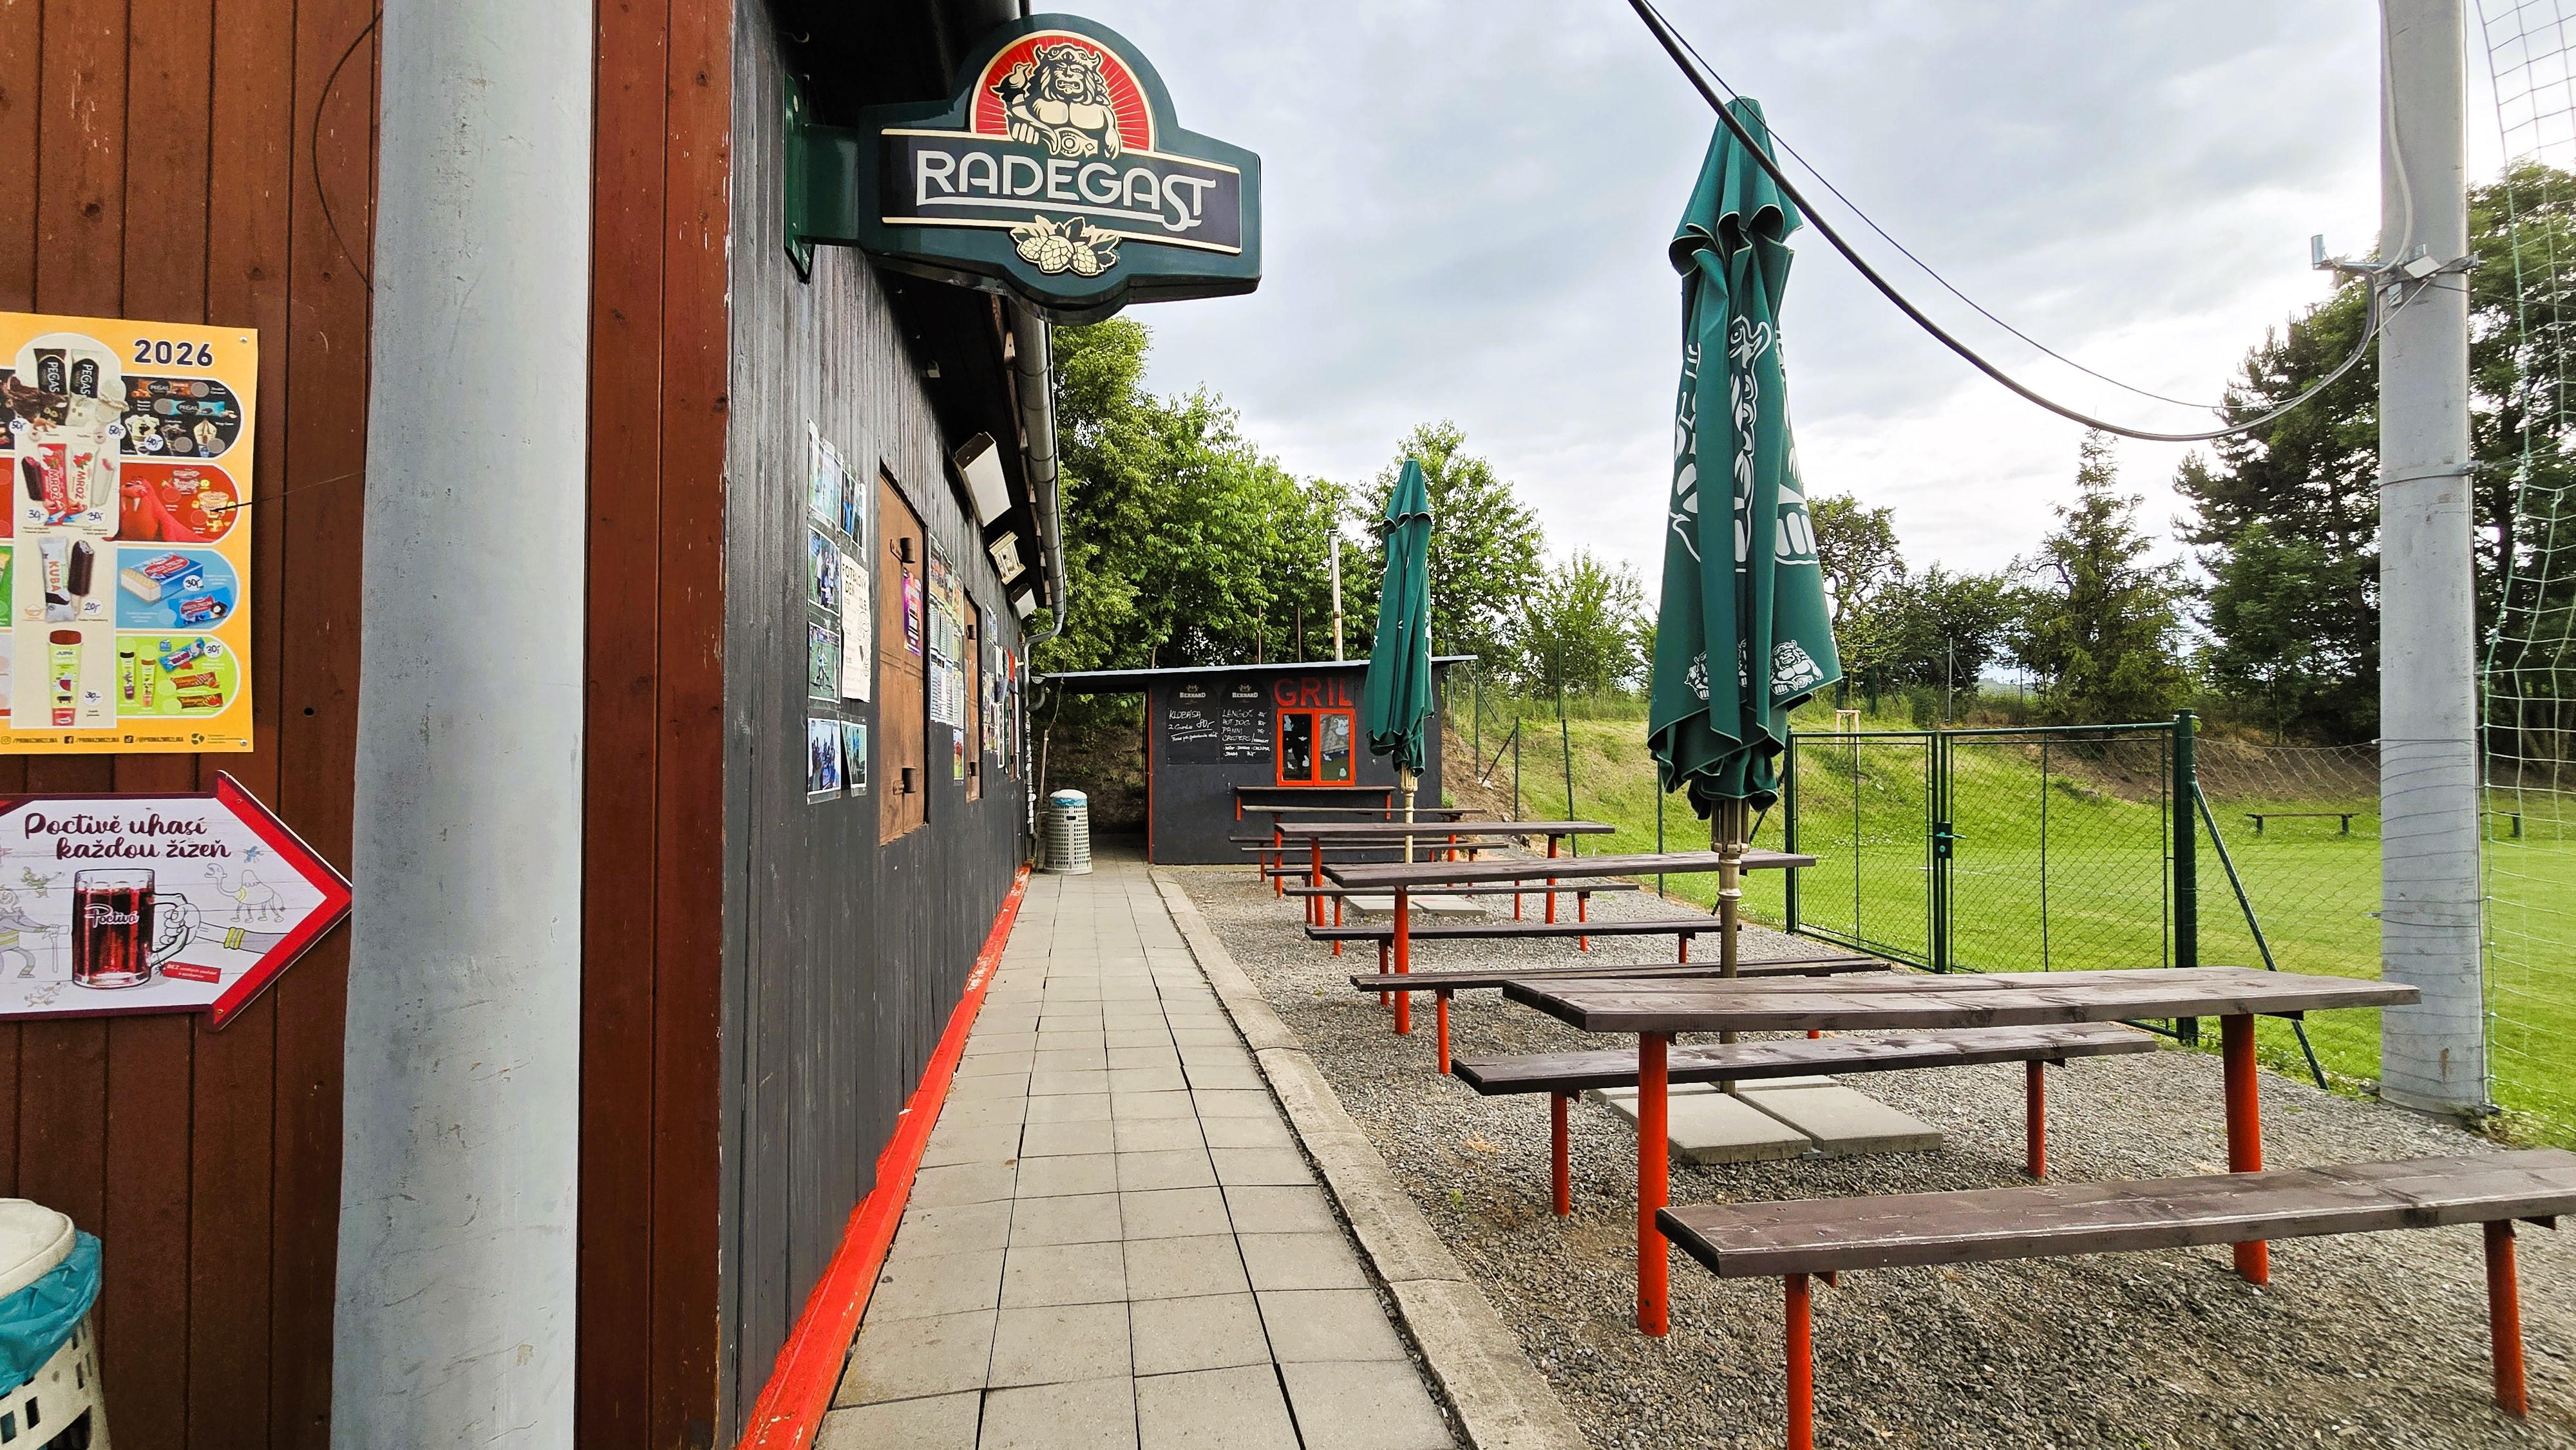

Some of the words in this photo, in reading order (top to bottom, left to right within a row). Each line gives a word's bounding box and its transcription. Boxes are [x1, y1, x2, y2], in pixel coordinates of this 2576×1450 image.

[916, 150, 1216, 232] RADEGAST
[134, 339, 213, 366] 2026
[47, 362, 61, 393] PEGAS
[80, 364, 93, 397] PEGAS
[48, 561, 61, 592] KUBA
[1274, 677, 1354, 706] GRIL
[24, 813, 123, 839] Poctivě
[129, 813, 207, 836] uhasí
[56, 837, 160, 860] každou
[166, 840, 231, 858] žízeň
[84, 903, 139, 928] Poctivá
